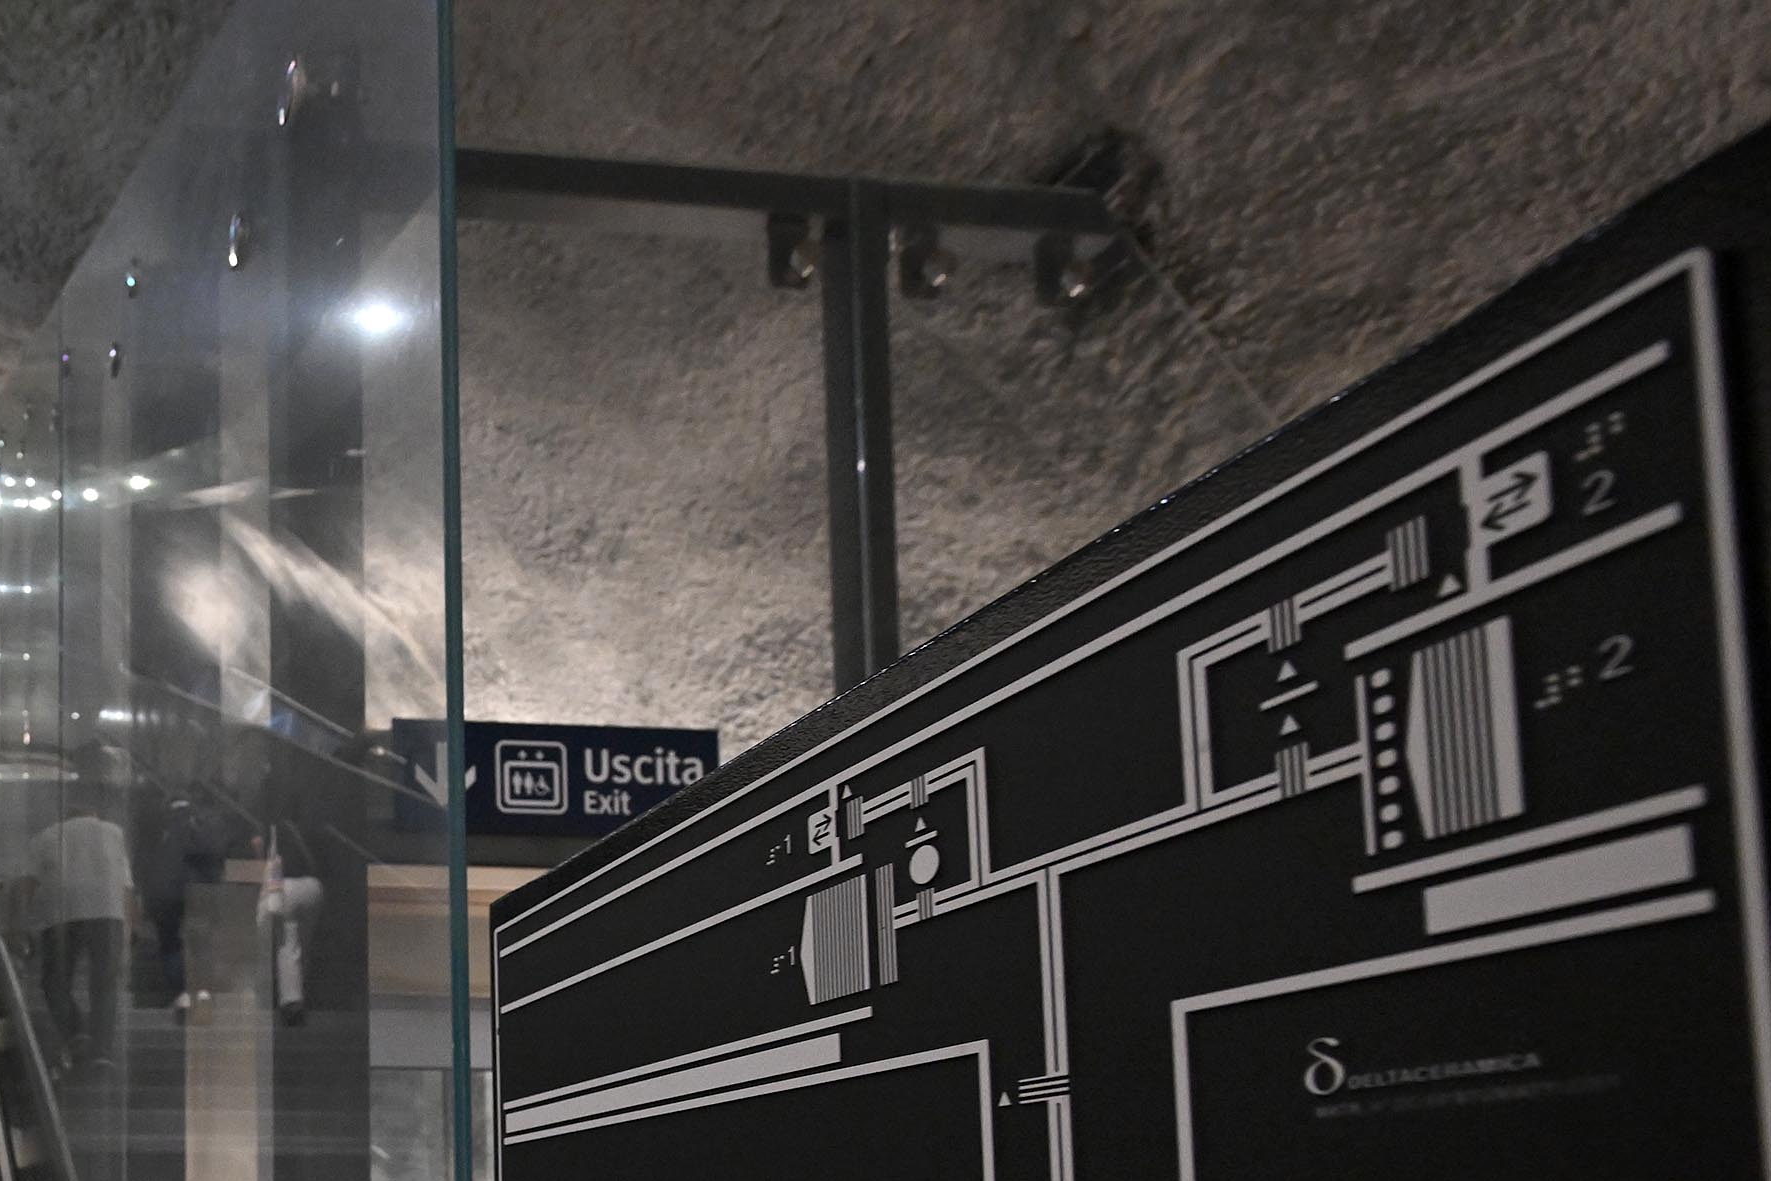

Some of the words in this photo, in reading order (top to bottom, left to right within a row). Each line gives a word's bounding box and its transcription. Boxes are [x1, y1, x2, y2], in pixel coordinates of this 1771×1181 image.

[1581, 469, 1618, 516] 2
[1597, 634, 1634, 680] 2
[584, 746, 704, 785] Uscita
[583, 788, 632, 816] Exit
[783, 834, 792, 855] 1
[788, 946, 796, 966] 1
